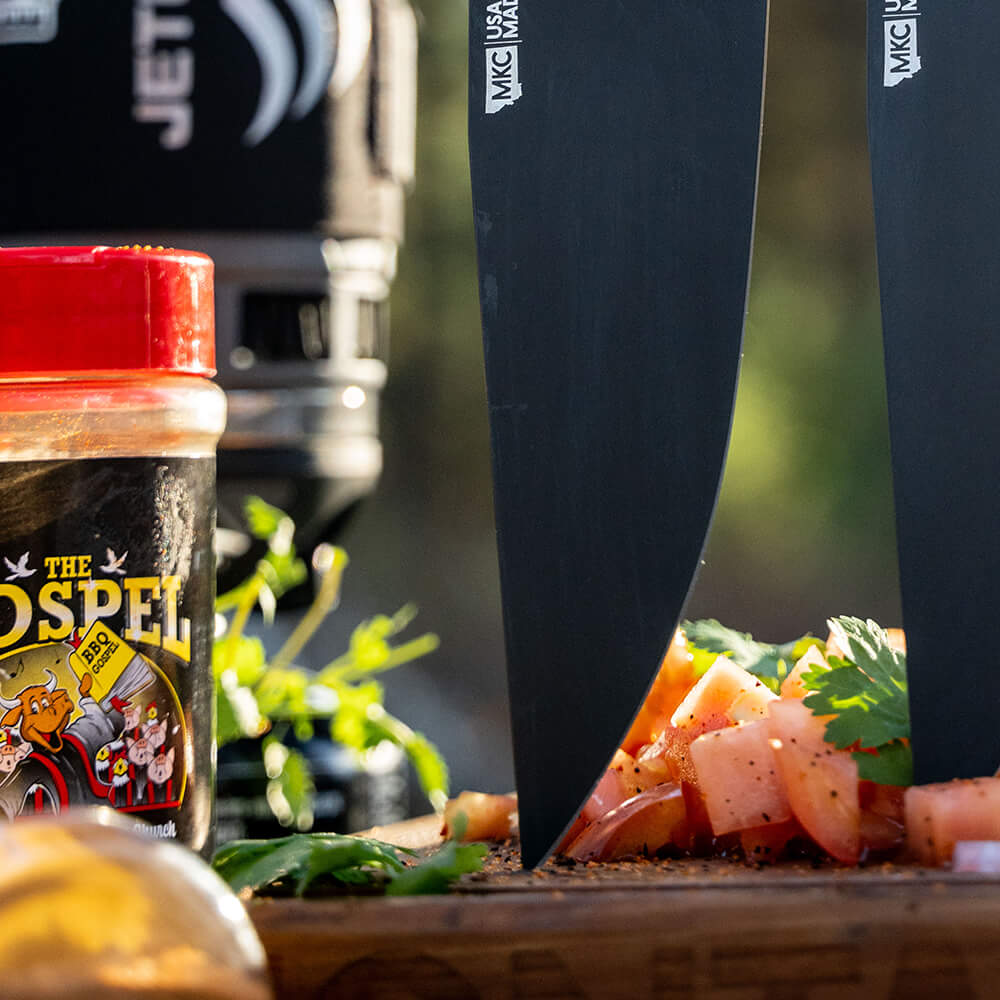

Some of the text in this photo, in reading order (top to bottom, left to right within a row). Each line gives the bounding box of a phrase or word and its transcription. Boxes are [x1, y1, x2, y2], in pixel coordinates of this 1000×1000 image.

[486, 0, 502, 39] USA
[889, 23, 911, 74] MKC
[491, 50, 512, 101] MKC
[44, 555, 92, 578] THE
[81, 631, 109, 665] BBQ
[91, 642, 120, 675] GOSPEL
